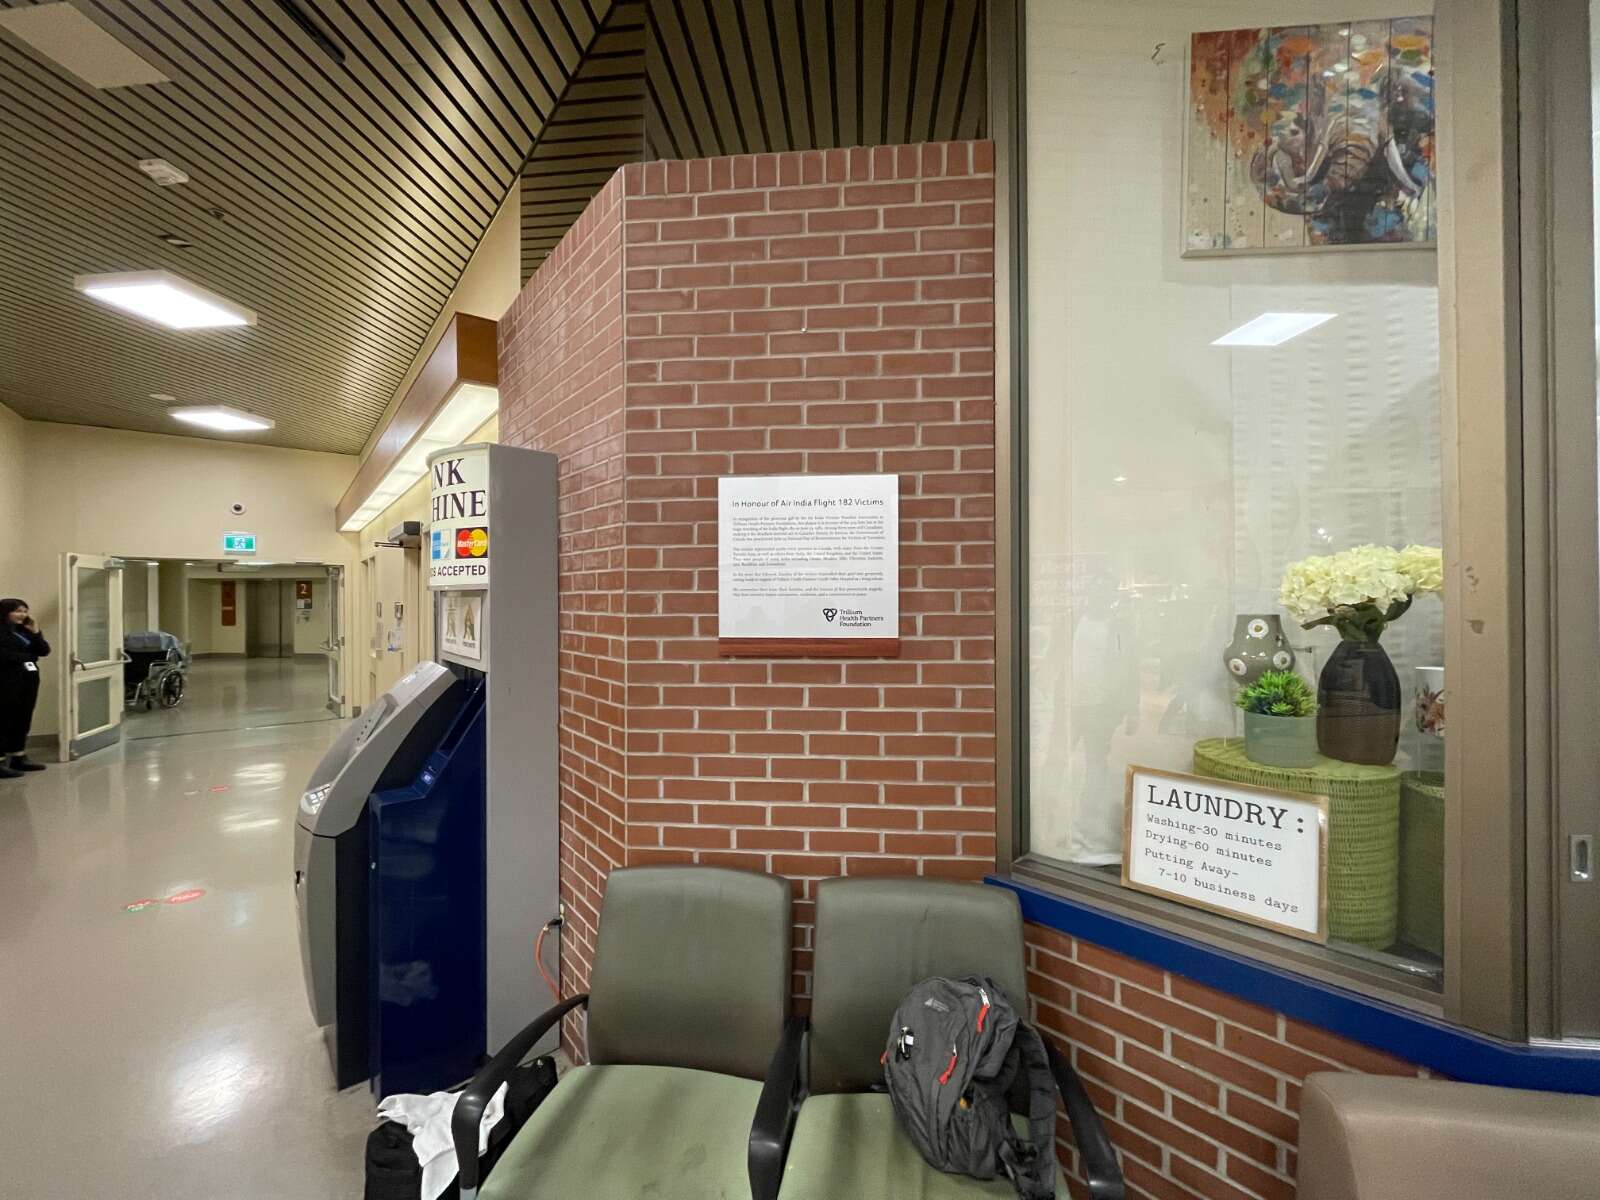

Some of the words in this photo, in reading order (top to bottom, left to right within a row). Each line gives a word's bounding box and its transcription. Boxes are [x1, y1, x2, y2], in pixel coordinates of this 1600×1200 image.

[732, 500, 740, 508] In
[741, 500, 770, 508] Honour
[770, 499, 779, 507] of
[780, 499, 791, 507] Air
[793, 499, 812, 507] India
[813, 498, 836, 508] Flight
[838, 498, 853, 506] 182
[854, 498, 884, 506] Victims
[437, 564, 486, 577] ACCEPTED
[1145, 829, 1209, 852] Drying-60
[1216, 848, 1273, 867] minutes
[1146, 813, 1218, 837] Washing-30
[1225, 831, 1282, 851] minutes
[1145, 847, 1194, 870] Putting
[1201, 861, 1240, 879] Away-
[1159, 867, 1187, 883] 7-10
[1194, 877, 1256, 902] business
[1264, 896, 1299, 914] days
